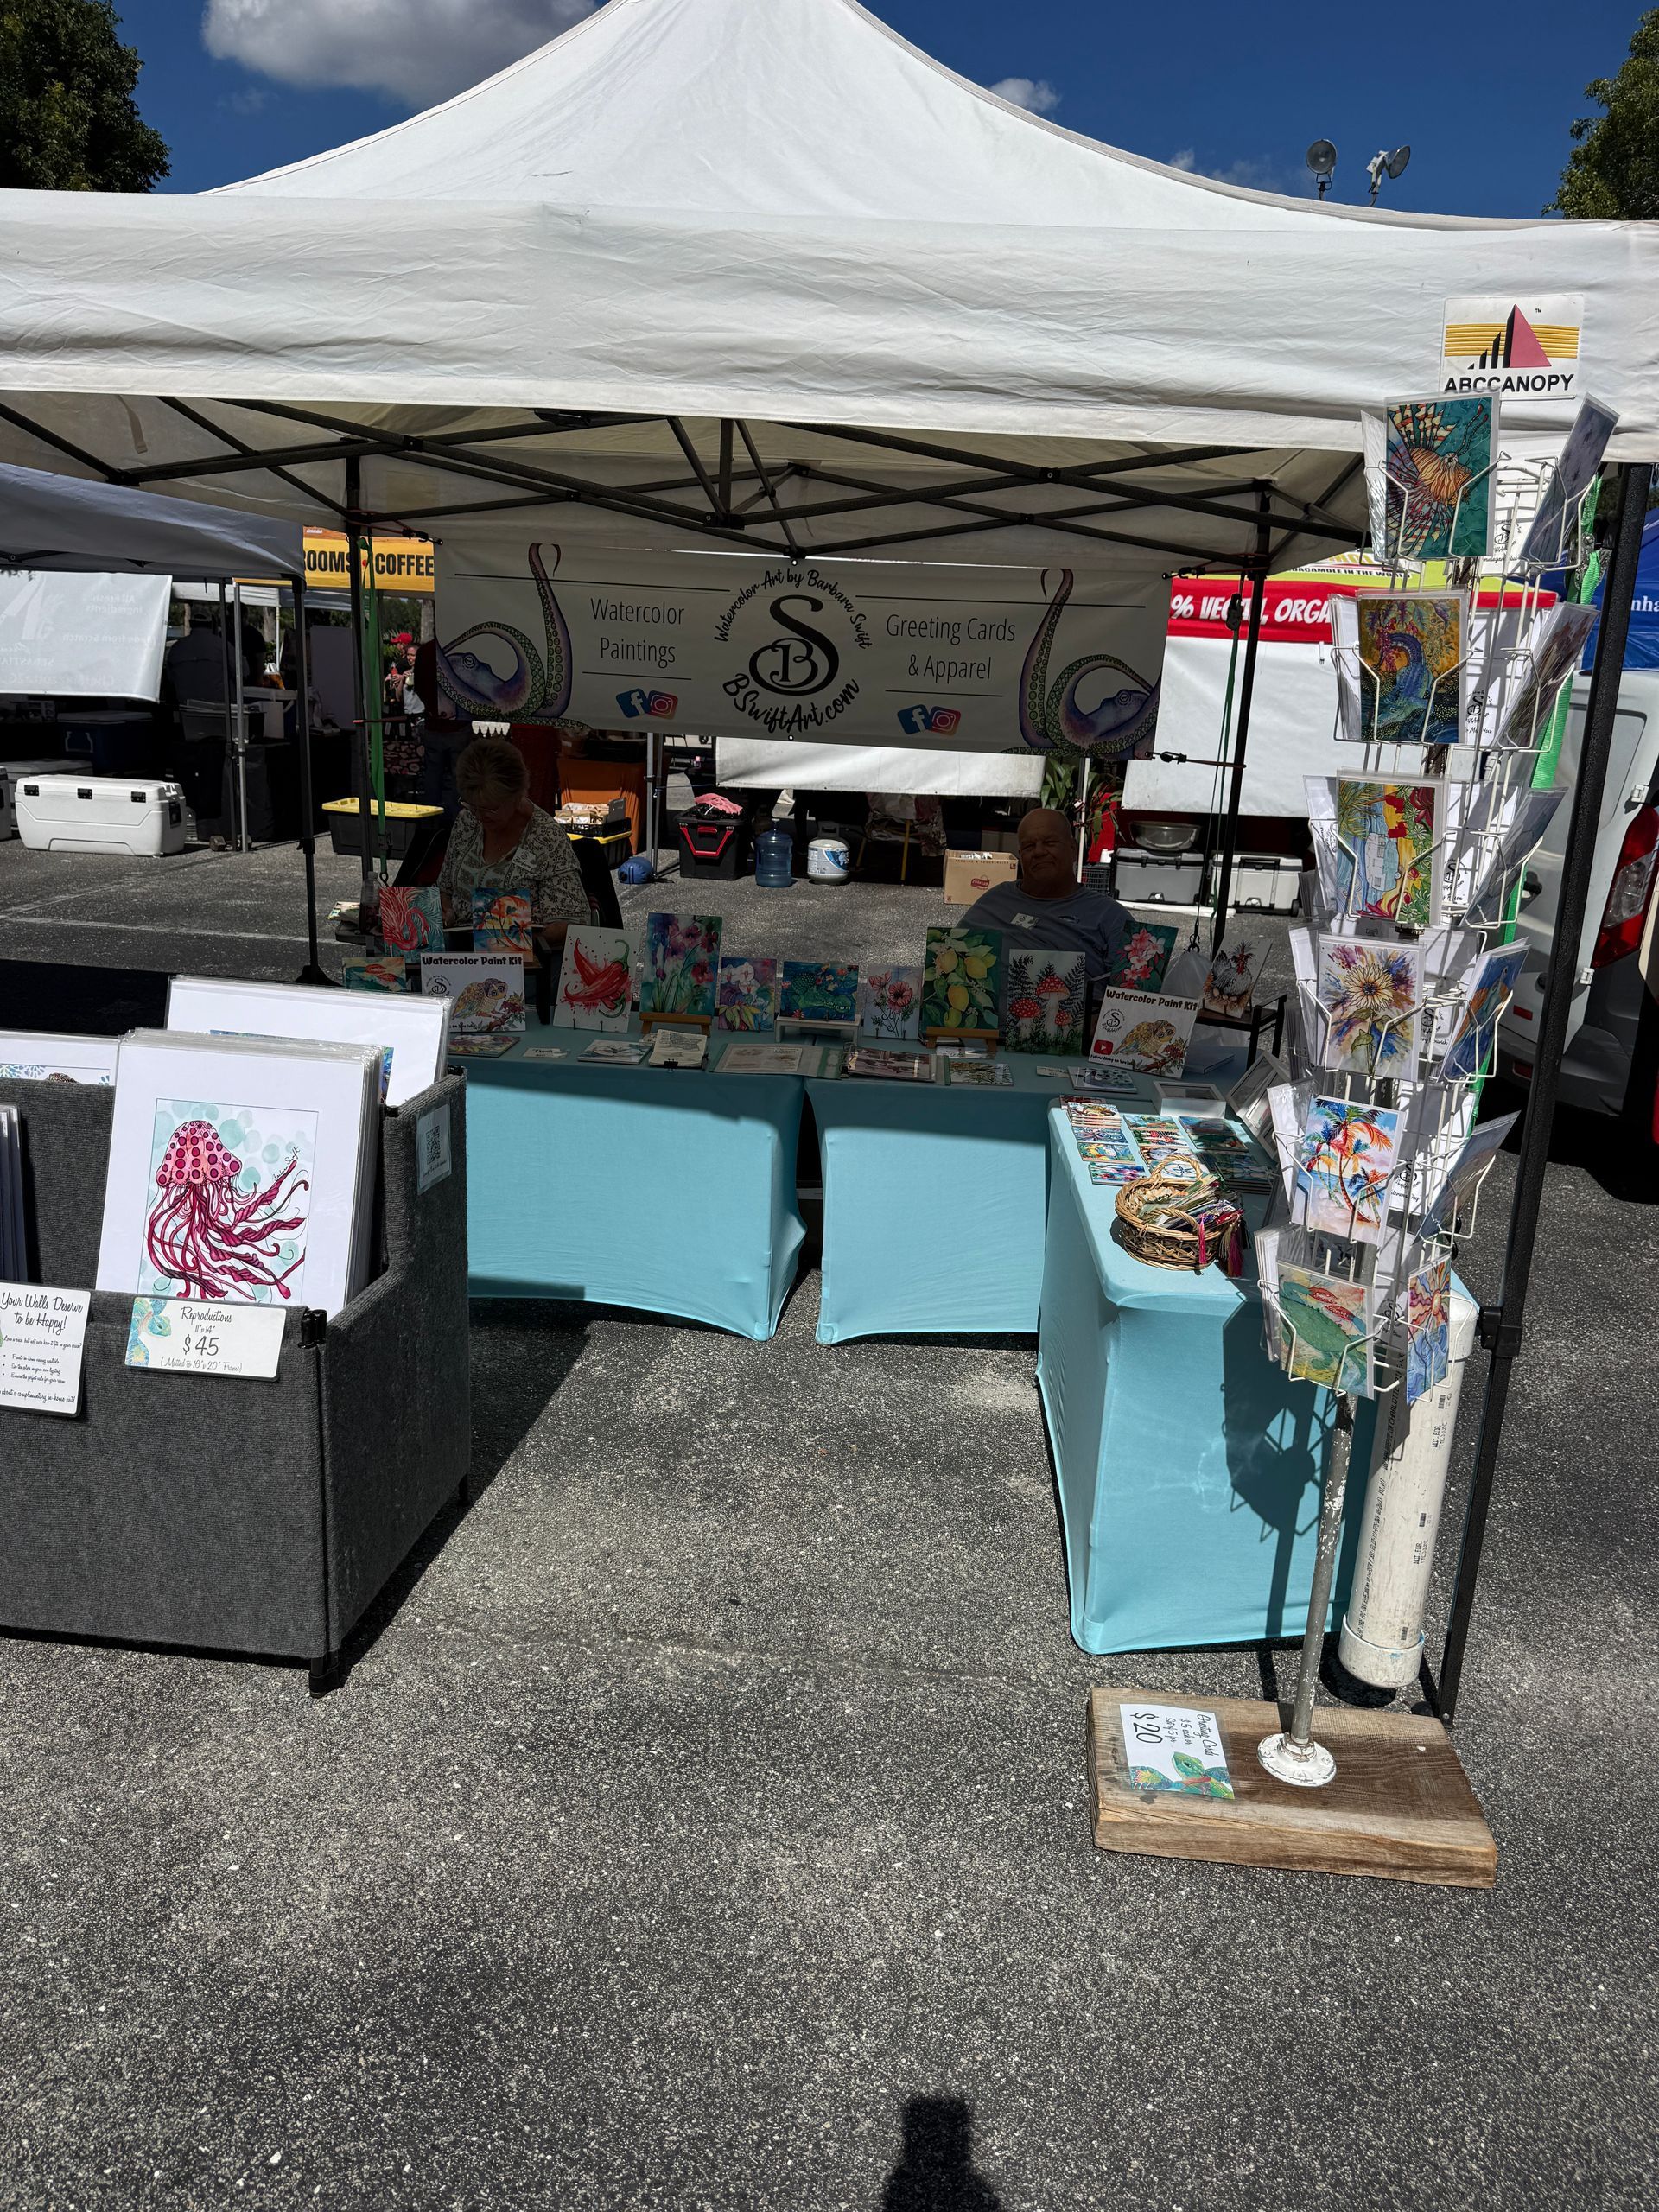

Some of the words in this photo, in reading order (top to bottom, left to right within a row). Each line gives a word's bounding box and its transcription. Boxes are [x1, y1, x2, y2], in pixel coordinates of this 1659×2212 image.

[1443, 374, 1574, 394] ABCCANOPY
[303, 550, 351, 574] OOMS
[375, 553, 434, 576] COFFEE
[590, 598, 684, 625] Watercolor
[715, 583, 760, 643] Watercolor
[761, 569, 785, 589] Art
[787, 568, 804, 588] by
[807, 569, 855, 613] Barbara
[850, 613, 873, 649] Swift
[887, 614, 961, 645] Greeting
[967, 618, 1016, 642] Cards
[601, 637, 676, 669] Paintings
[908, 654, 918, 677] &
[923, 655, 992, 684] Apparel
[722, 673, 860, 734] BSwiftArt.com
[422, 957, 479, 965] Watercolor
[480, 957, 507, 965] Paint
[509, 957, 523, 965] Kit
[1106, 989, 1156, 1004] Watercolor
[1158, 997, 1182, 1008] Paint
[1184, 1001, 1198, 1011] Kit
[0, 1292, 23, 1310] Your
[25, 1294, 48, 1309] Walls
[52, 1296, 83, 1313] Deserve
[181, 1306, 232, 1325] Reproductions
[14, 1312, 23, 1324] to
[25, 1312, 34, 1325] be
[36, 1313, 67, 1336] Happy!
[1193, 1714, 1211, 1738] Greeting
[1202, 1739, 1219, 1756] Cards
